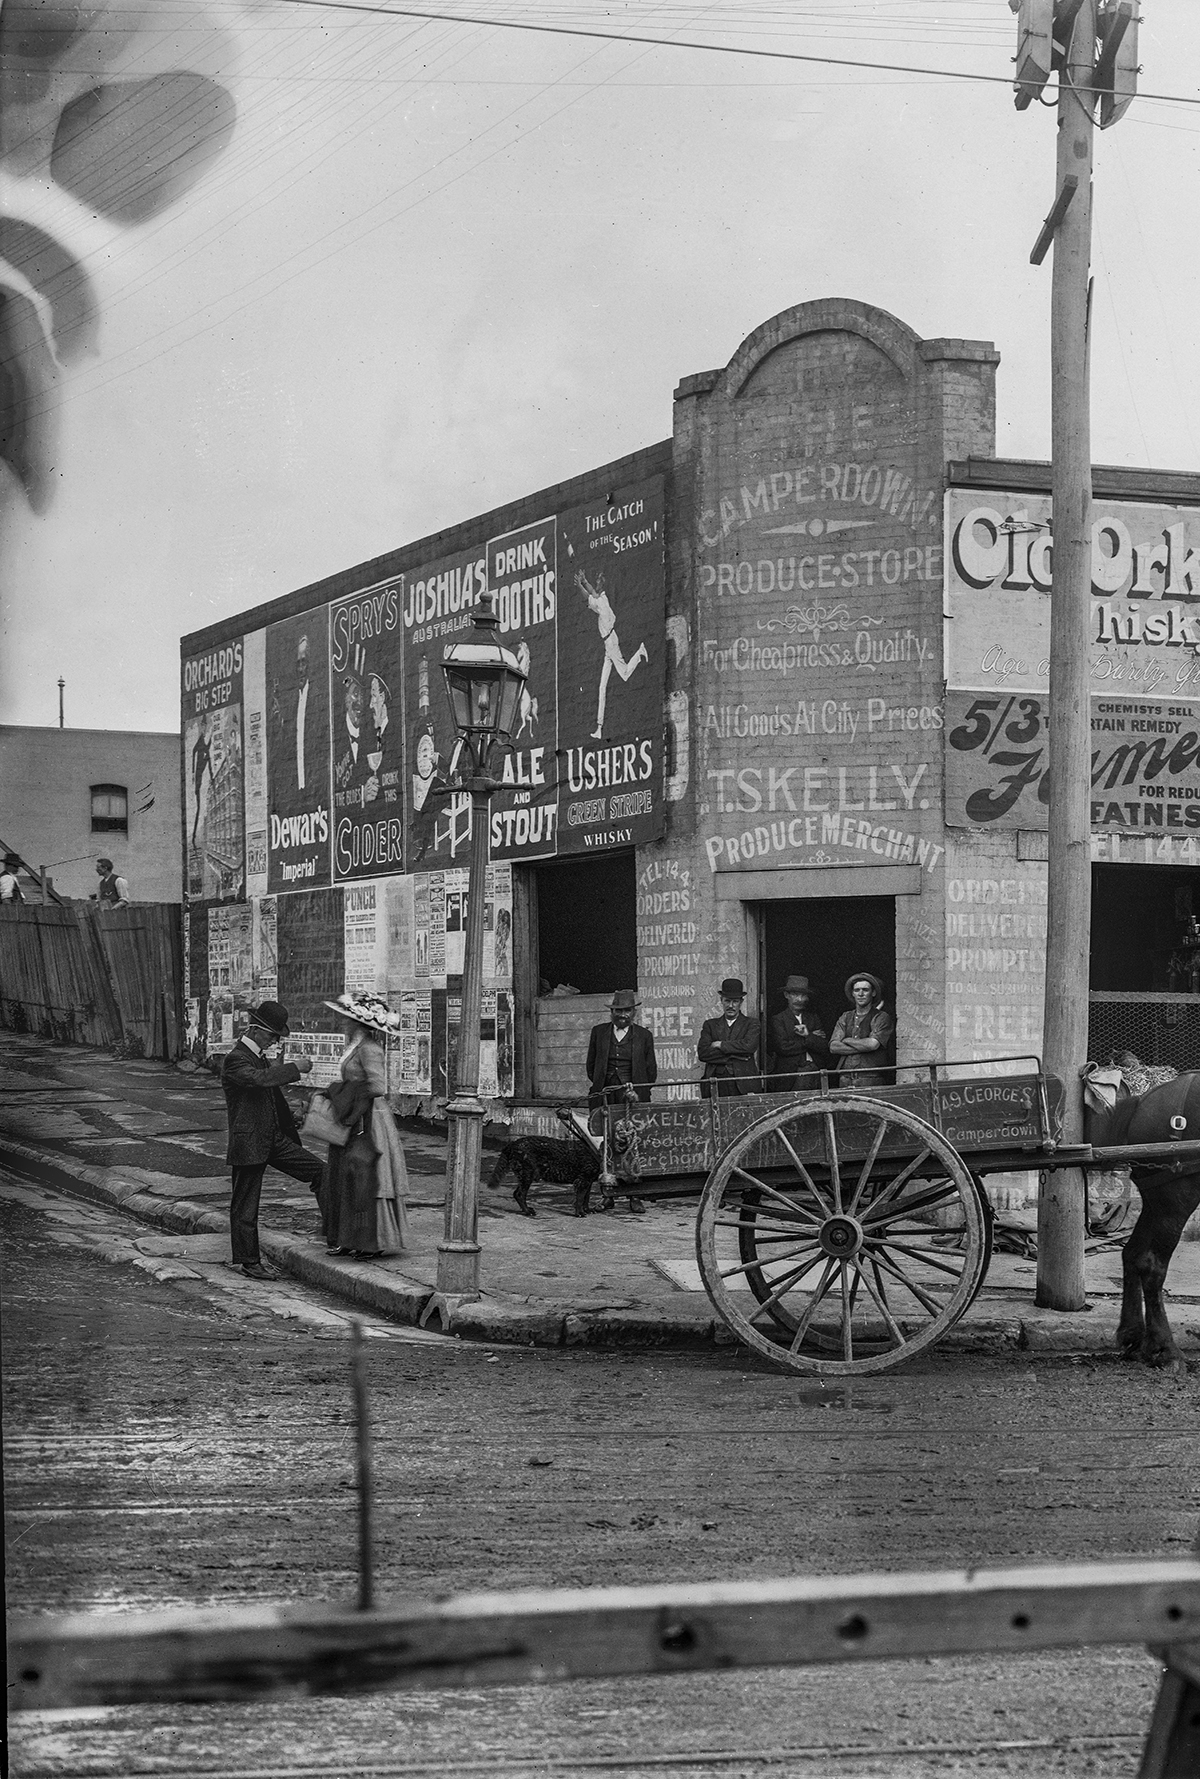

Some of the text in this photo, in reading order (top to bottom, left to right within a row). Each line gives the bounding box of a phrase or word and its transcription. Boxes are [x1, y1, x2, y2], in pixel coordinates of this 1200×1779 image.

[585, 499, 644, 534] THE CATCH
[590, 520, 658, 555] OF THE SEASON!
[495, 537, 548, 579] DRINK
[403, 558, 486, 628] JOSHUA'S
[490, 564, 555, 634] TOOTH'S
[332, 588, 398, 673] SPRY'S
[184, 642, 243, 693] ORCHARD'S
[733, 637, 842, 675] Cheapness
[842, 649, 855, 666] &
[981, 643, 1029, 685] Age
[195, 681, 232, 711] BIG STEP
[1097, 703, 1194, 718] CHEMISTS SELL
[794, 701, 818, 735] At
[821, 700, 860, 743] City
[949, 696, 1041, 755] 5/3
[1130, 719, 1182, 734] REMEDY
[502, 746, 545, 786] ALE
[566, 736, 654, 793] USHER'S
[513, 791, 531, 805] AND
[568, 789, 653, 827] GREEN STRIPE
[1139, 785, 1165, 798] FOR
[270, 804, 328, 849] Dewar's
[491, 803, 557, 848] STOUT
[583, 827, 634, 847] WHISKY
[705, 812, 944, 873] PRODUCE MERCHANT
[335, 816, 402, 875] CIDER
[636, 889, 690, 916] ORDERS
[637, 921, 697, 947] DELIVERED
[644, 953, 701, 977] PROMPTLY
[641, 1006, 694, 1037] FREE
[952, 1004, 1041, 1041] FREE
[667, 1078, 700, 1102] DONE
[631, 1112, 711, 1131] SKELLY
[945, 1123, 1038, 1143] Camperdown
[638, 1139, 709, 1171] erchant
